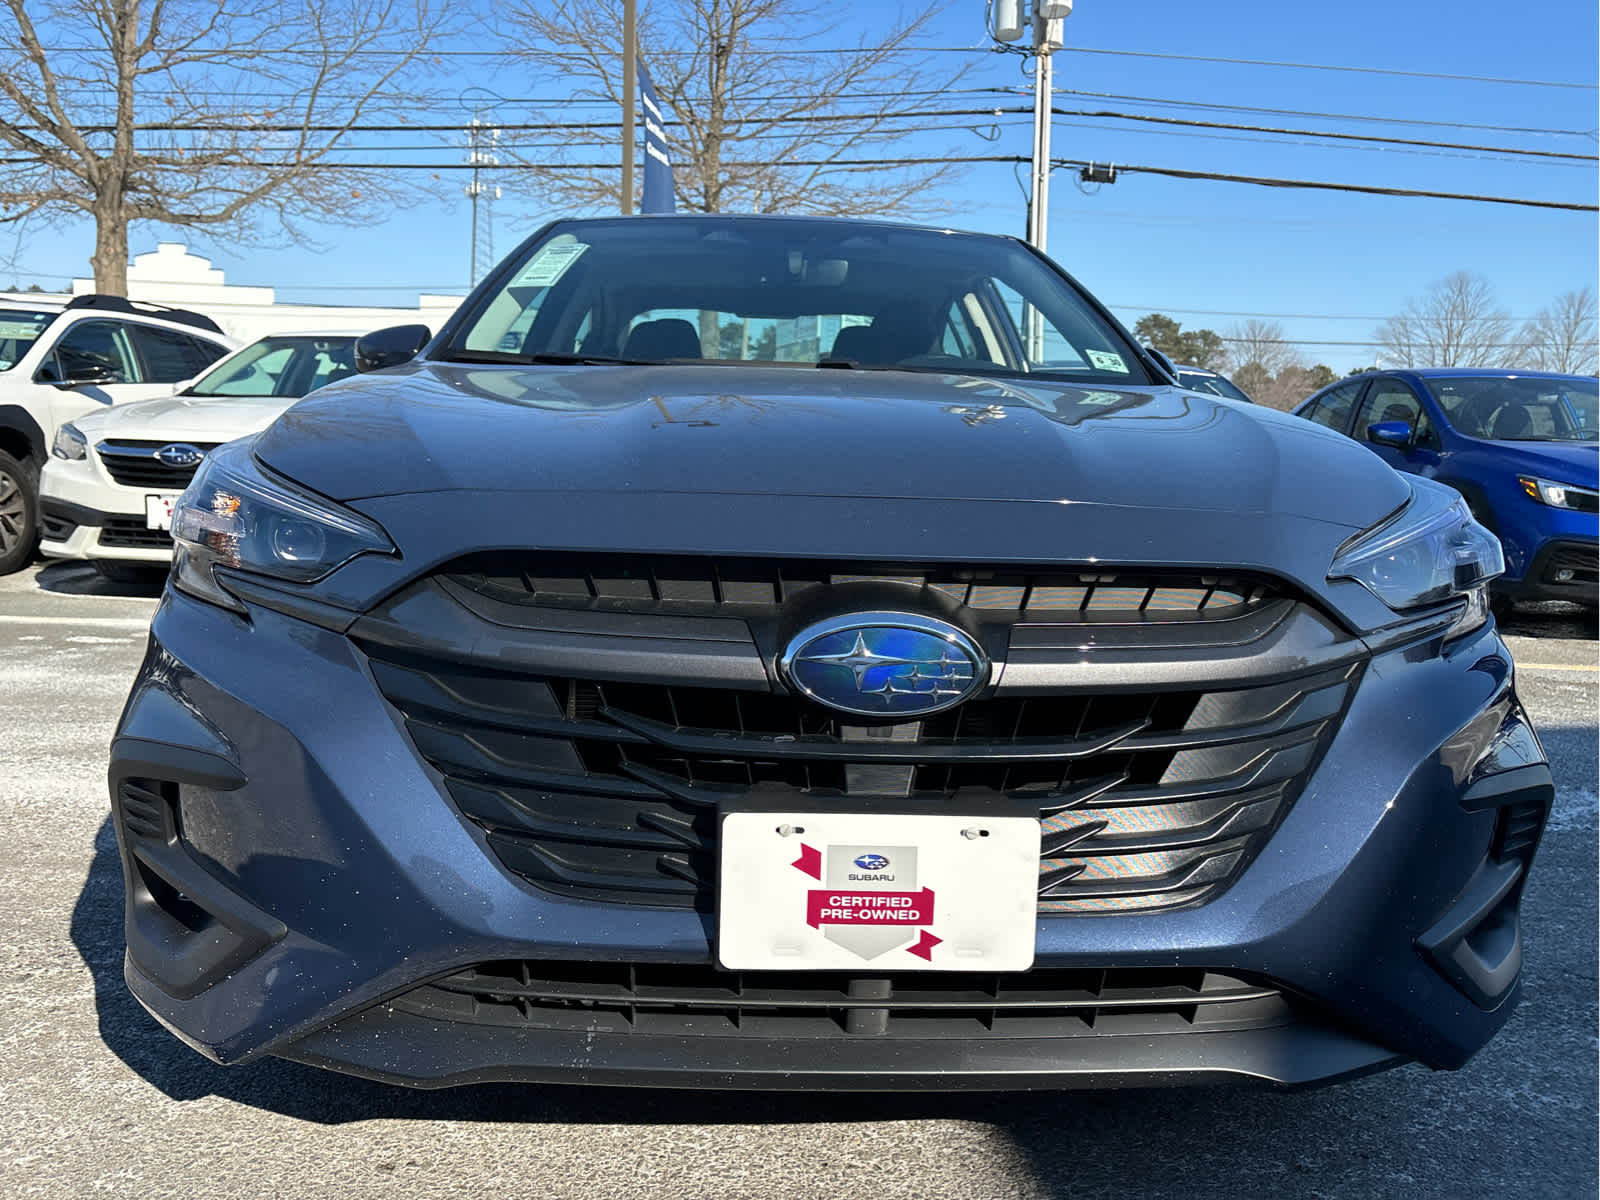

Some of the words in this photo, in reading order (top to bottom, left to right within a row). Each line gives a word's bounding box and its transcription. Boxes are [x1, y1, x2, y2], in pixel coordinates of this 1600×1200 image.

[848, 873, 895, 881] SUBARU
[829, 896, 912, 907] CERTIFIED
[820, 908, 920, 920] PRE-OWNED
